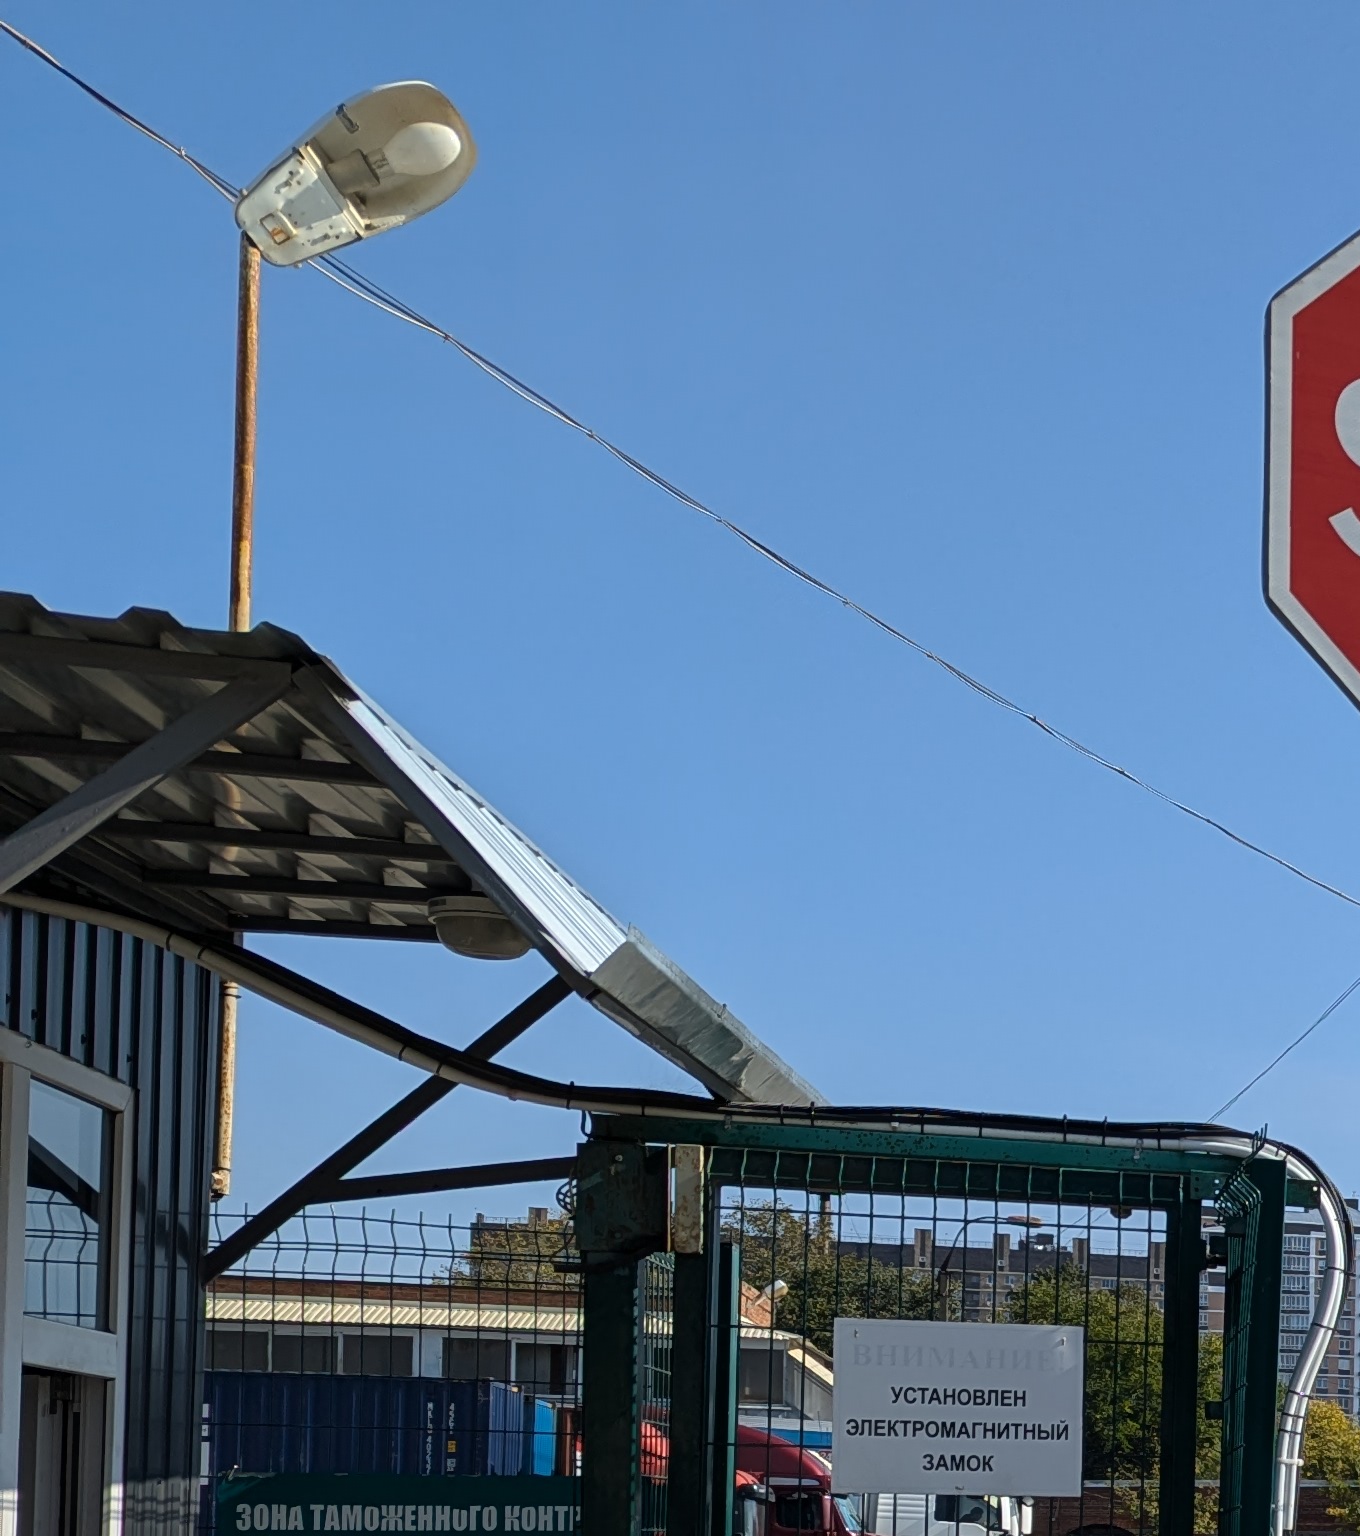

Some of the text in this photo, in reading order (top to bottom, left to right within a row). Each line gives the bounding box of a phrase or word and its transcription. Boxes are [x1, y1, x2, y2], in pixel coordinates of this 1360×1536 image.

[890, 1386, 1027, 1407] УСТАНОВЛЕН
[845, 1419, 1069, 1441] ЭЛЕКТРОМАГНИТНЫЙ
[922, 1454, 995, 1472] ЗАМОК
[235, 1503, 581, 1532] ЗОНА ТАМОЖЕННОГО КОНТР
